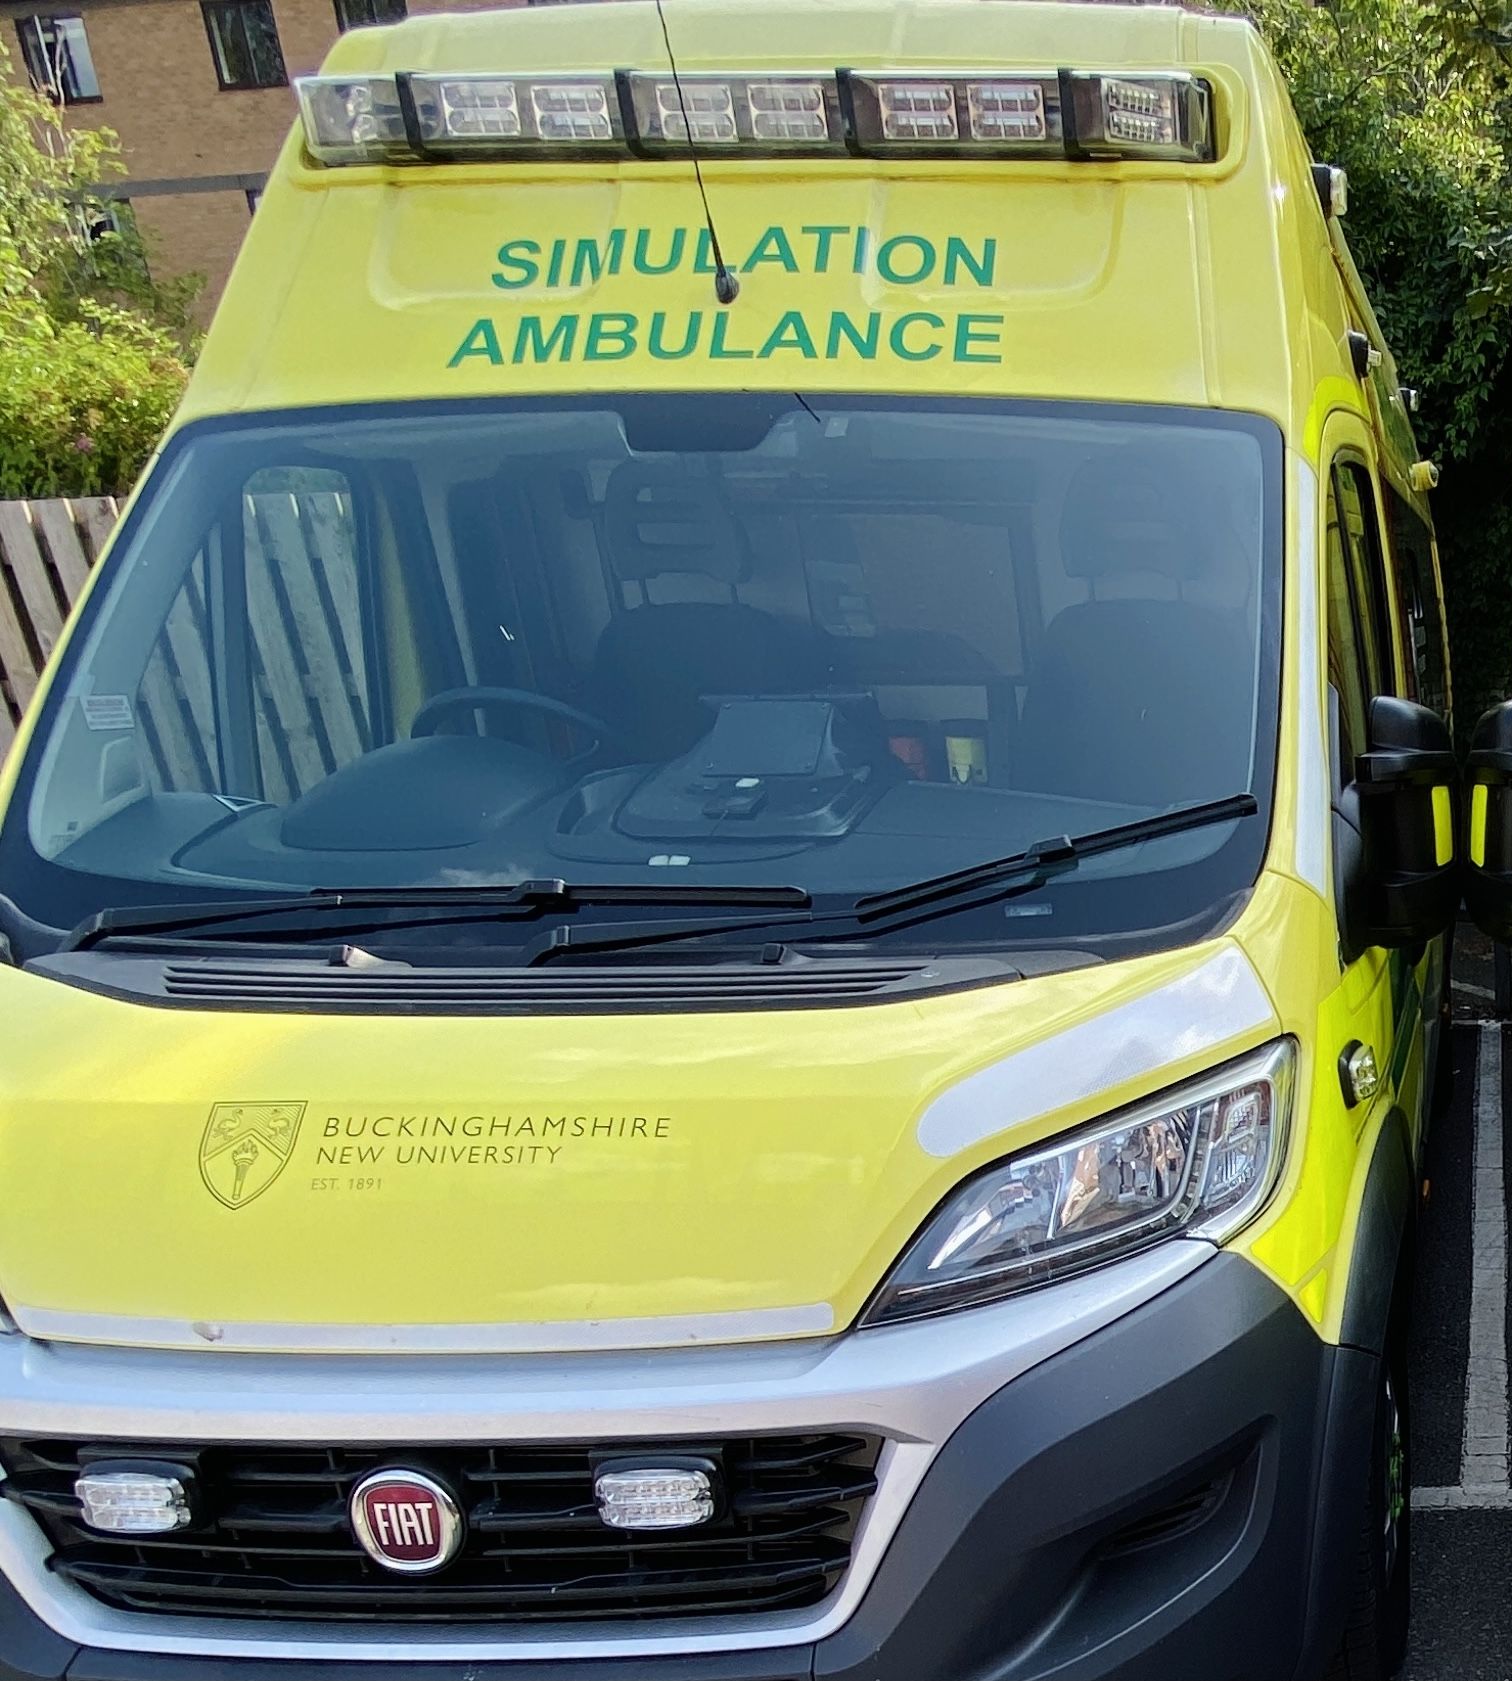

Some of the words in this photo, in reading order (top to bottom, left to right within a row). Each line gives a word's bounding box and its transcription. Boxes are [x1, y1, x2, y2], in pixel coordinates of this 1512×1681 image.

[490, 226, 997, 290] SIMULATION
[446, 311, 1005, 368] AMBULANCE
[322, 1116, 673, 1139] BUCKINGHAMSHIRE
[315, 1145, 385, 1165] NEW
[395, 1145, 563, 1165] UNIVERSITY
[310, 1177, 341, 1192] EST.
[347, 1177, 383, 1191] 1891
[372, 1502, 435, 1546] FIAT
